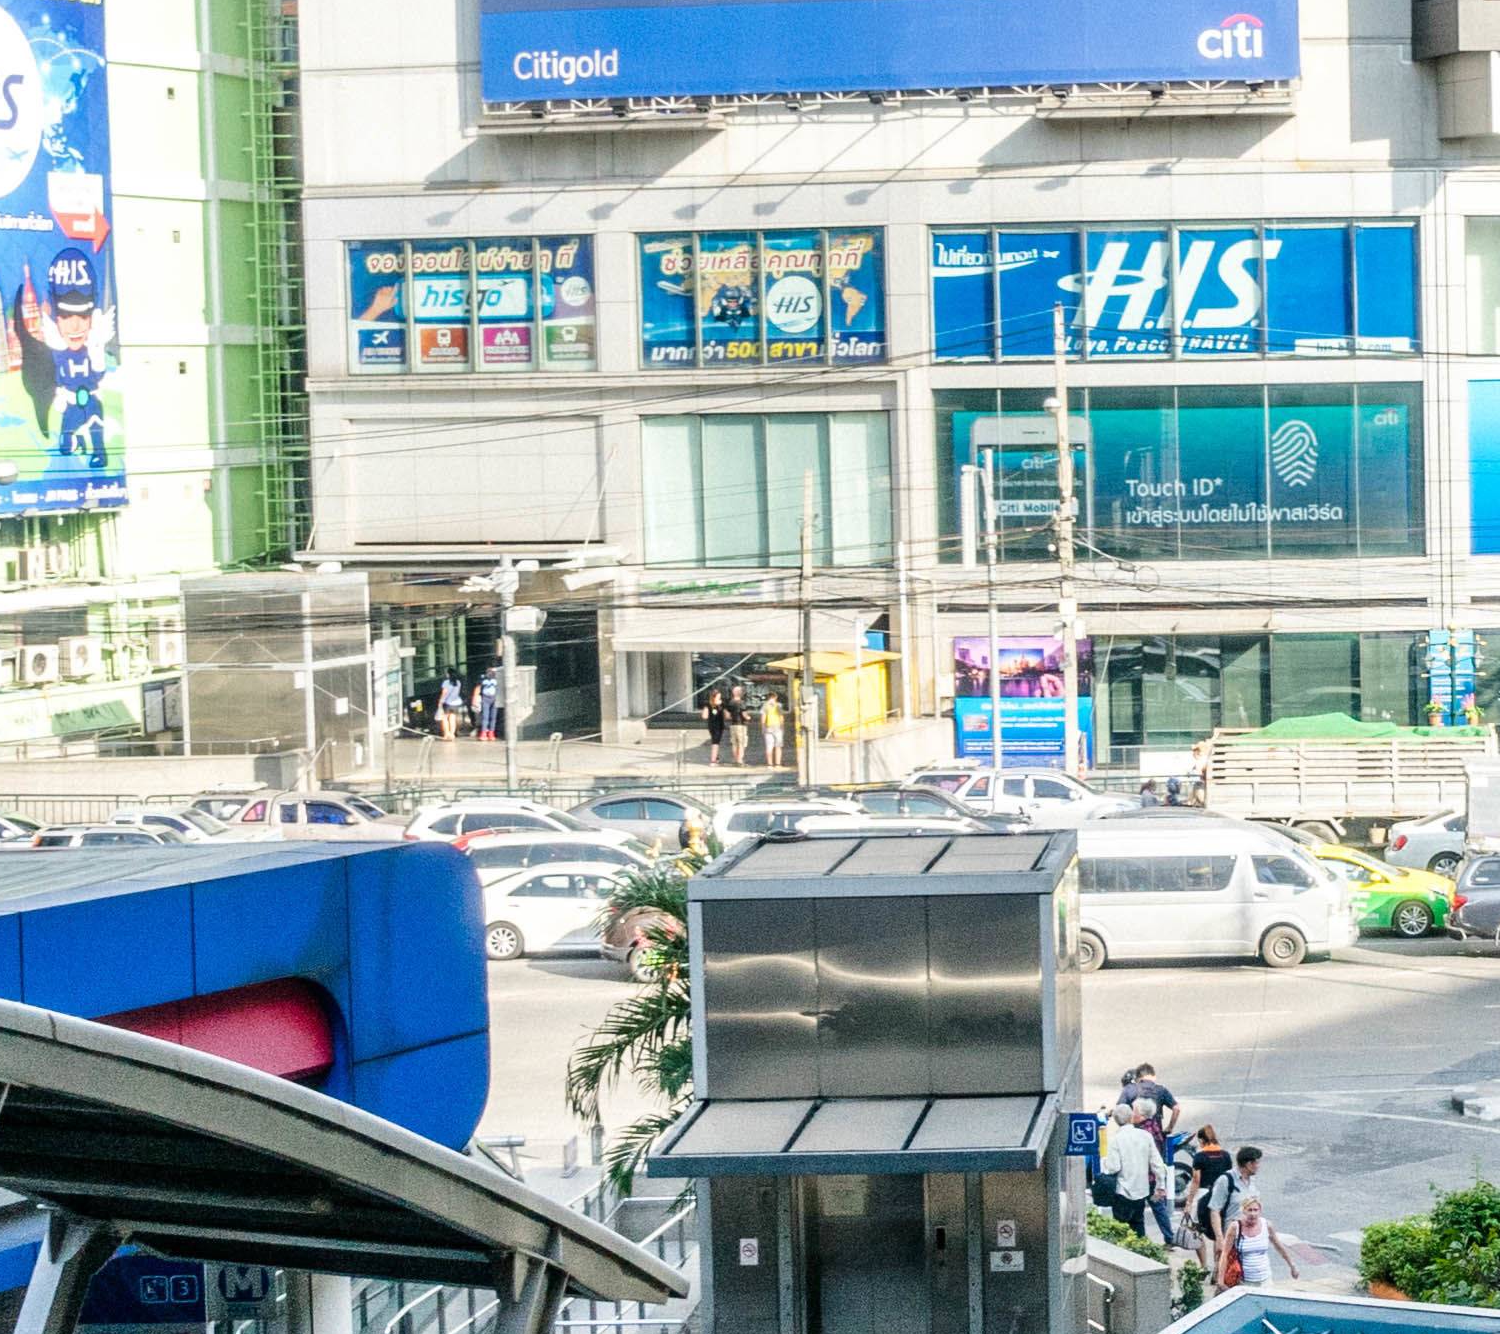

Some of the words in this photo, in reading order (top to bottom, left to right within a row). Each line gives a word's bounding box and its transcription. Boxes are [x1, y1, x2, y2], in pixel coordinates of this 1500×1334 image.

[1197, 18, 1263, 58] citi
[513, 49, 619, 85] Citigold
[421, 284, 503, 315] hisgo
[773, 296, 816, 314] HIS
[770, 341, 818, 360] สาขา
[1125, 479, 1186, 496] Touch
[999, 502, 1019, 513] Citi
[1023, 501, 1061, 513] Mobile
[1126, 501, 1343, 528] เข้าสู่ระบบโดยไม่ใช้พาสเวิร์ด
